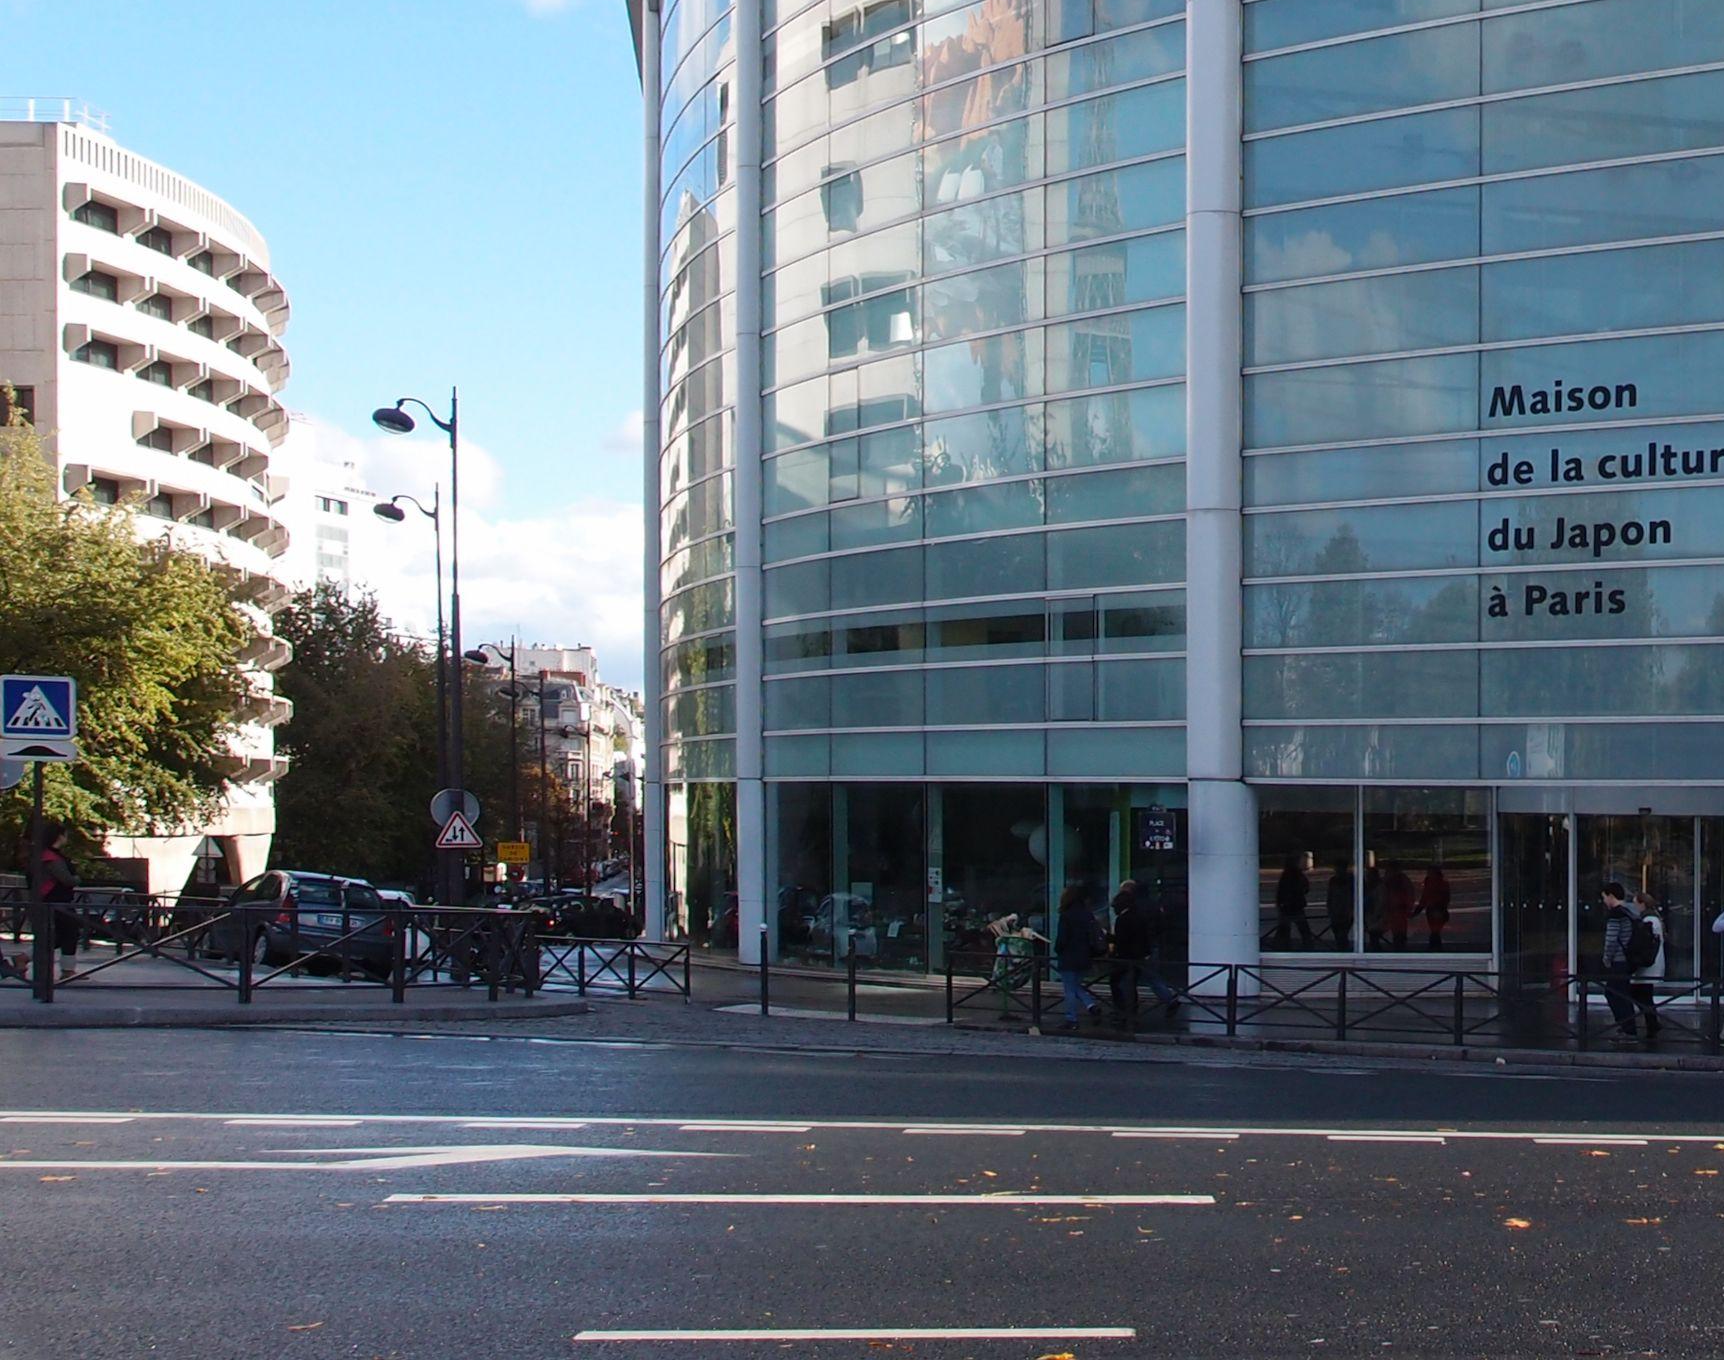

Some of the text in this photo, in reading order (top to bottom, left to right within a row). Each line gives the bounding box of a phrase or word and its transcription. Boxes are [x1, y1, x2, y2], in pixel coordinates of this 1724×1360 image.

[1488, 379, 1638, 418] Maison
[1487, 452, 1534, 486] de
[1551, 448, 1585, 482] la
[1488, 516, 1672, 558] du Japon
[1487, 580, 1627, 618] à Paris
